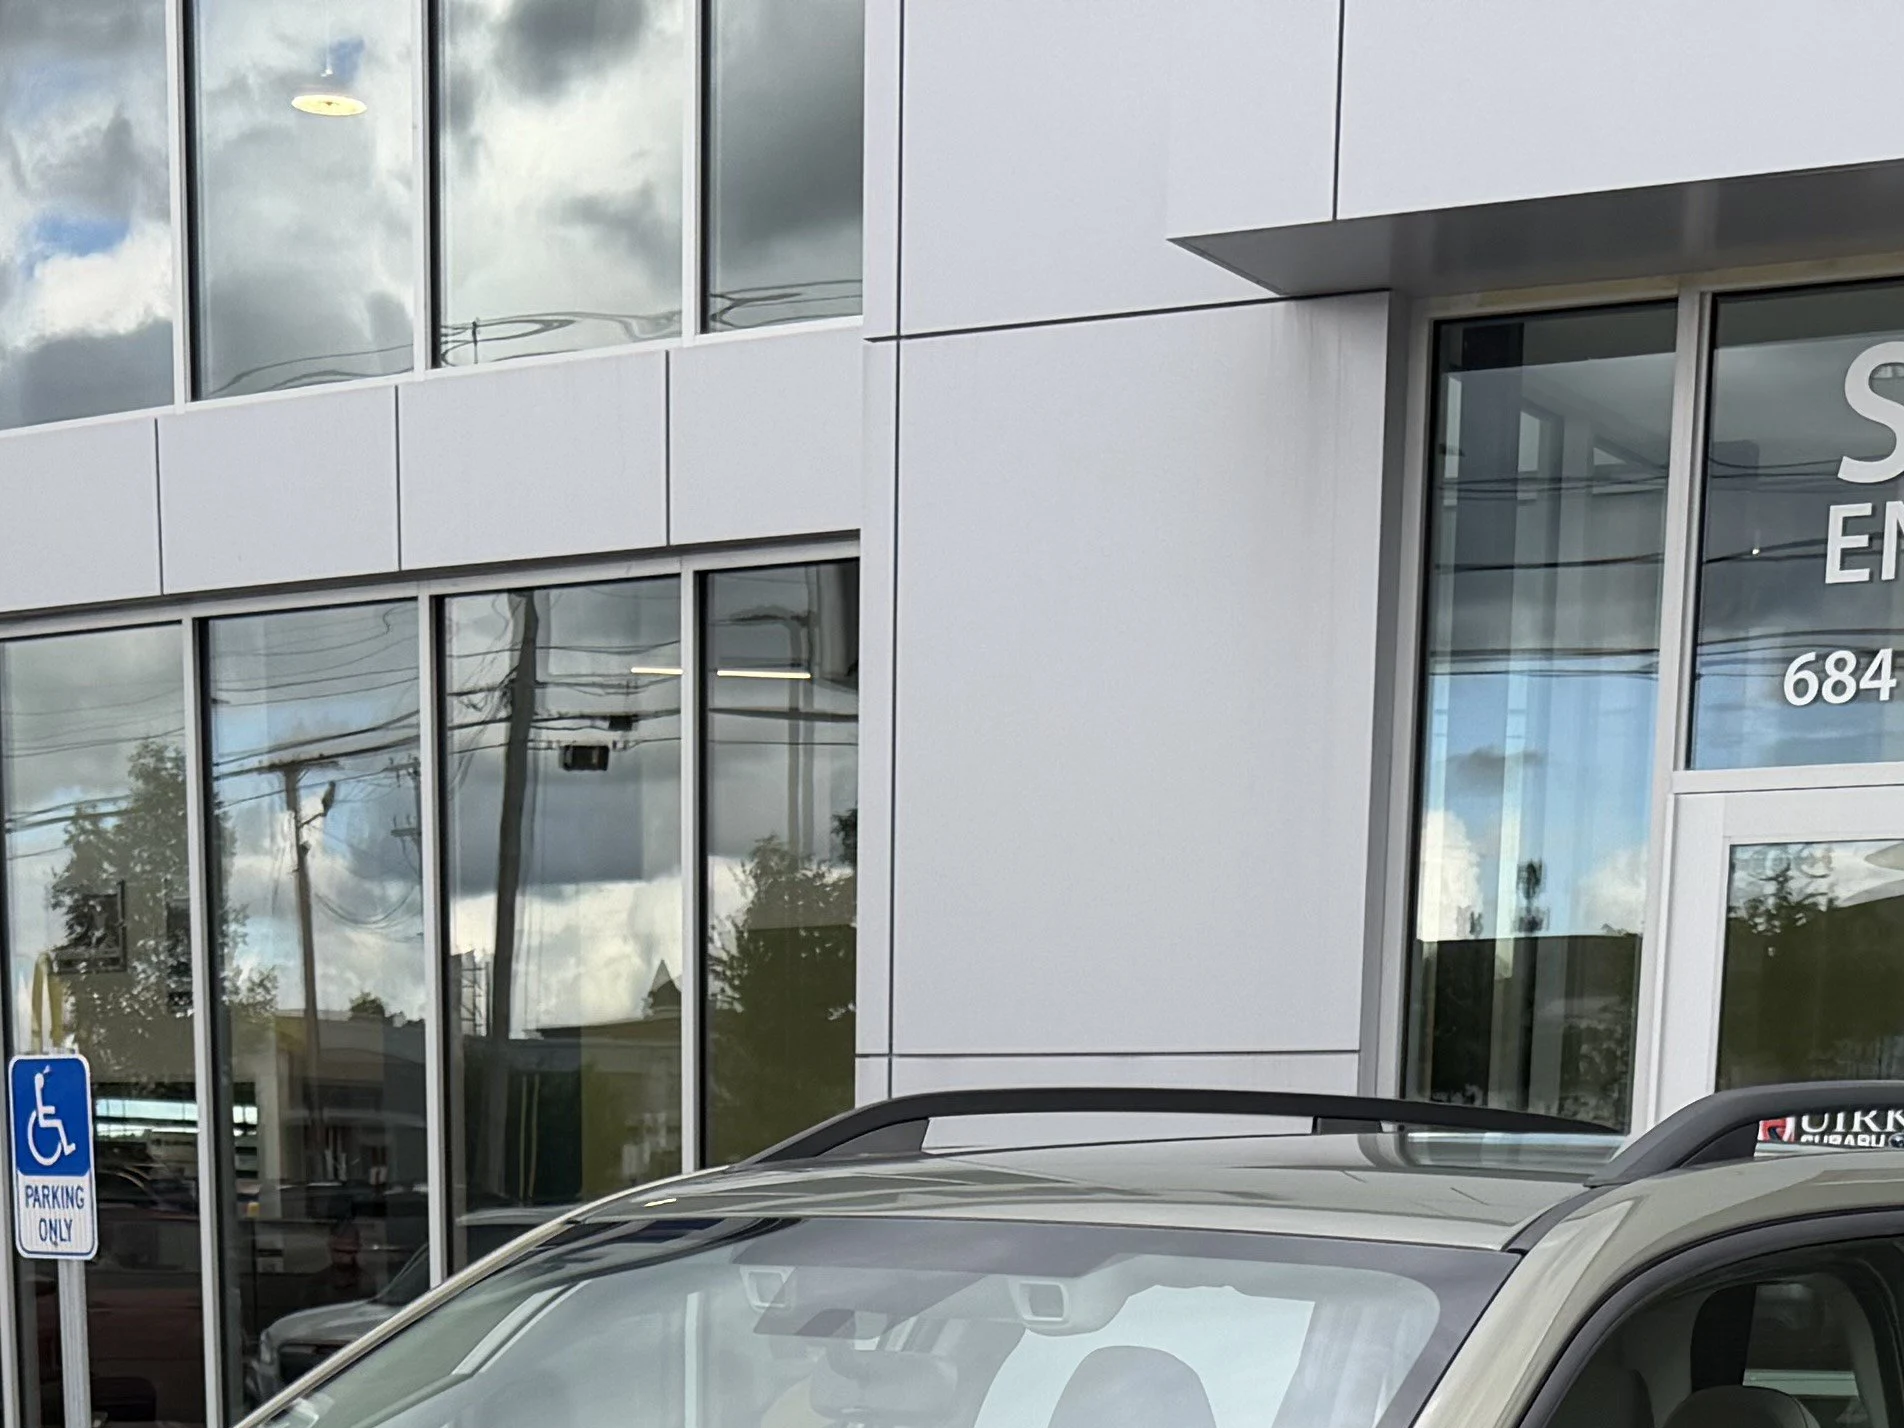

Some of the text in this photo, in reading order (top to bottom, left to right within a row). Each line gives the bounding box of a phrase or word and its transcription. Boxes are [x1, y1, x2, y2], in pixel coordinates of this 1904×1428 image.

[1783, 641, 1897, 707] 684
[24, 1185, 84, 1210] PARKING
[39, 1218, 73, 1243] ONLY
